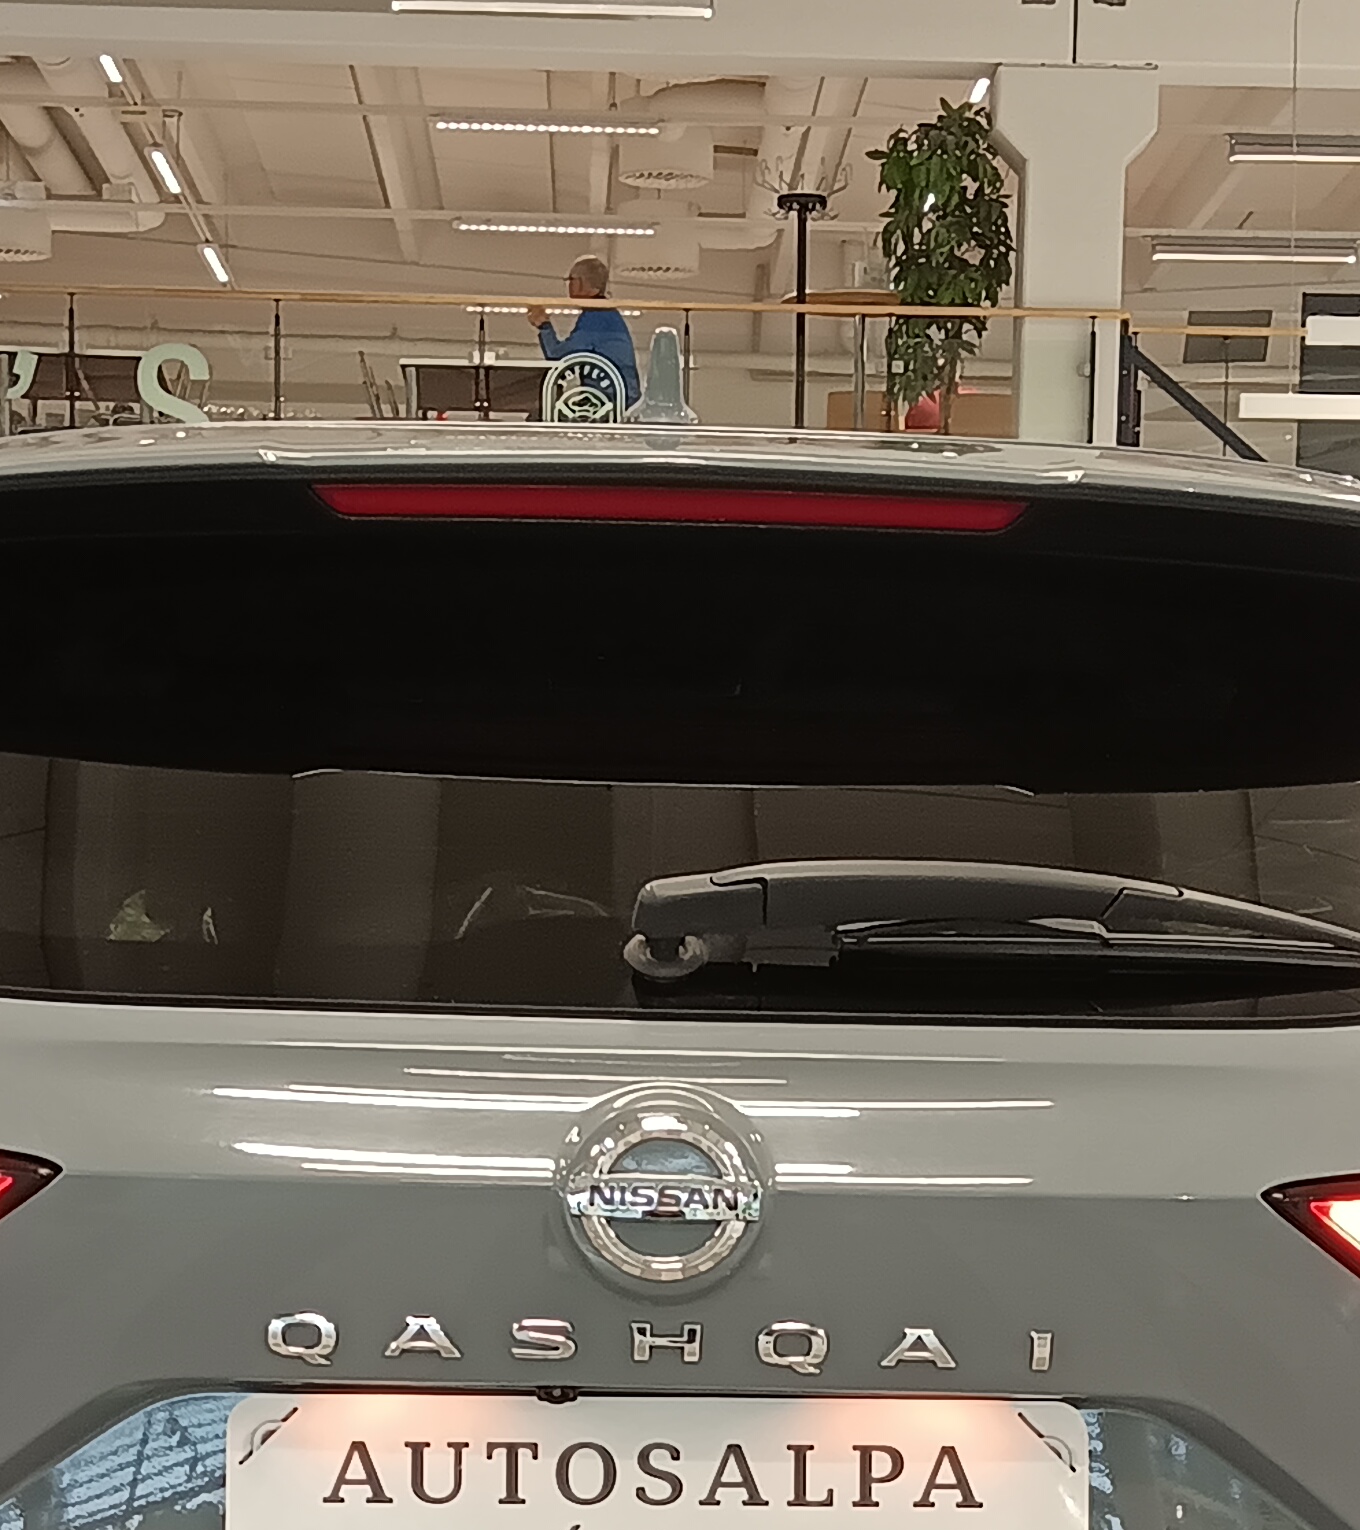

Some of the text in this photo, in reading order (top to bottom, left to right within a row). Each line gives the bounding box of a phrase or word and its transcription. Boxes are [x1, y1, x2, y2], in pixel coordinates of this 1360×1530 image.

[590, 1183, 739, 1211] NISSAN
[267, 1311, 1053, 1375] QASHQAI
[322, 1440, 984, 1509] AUTOSALPA
